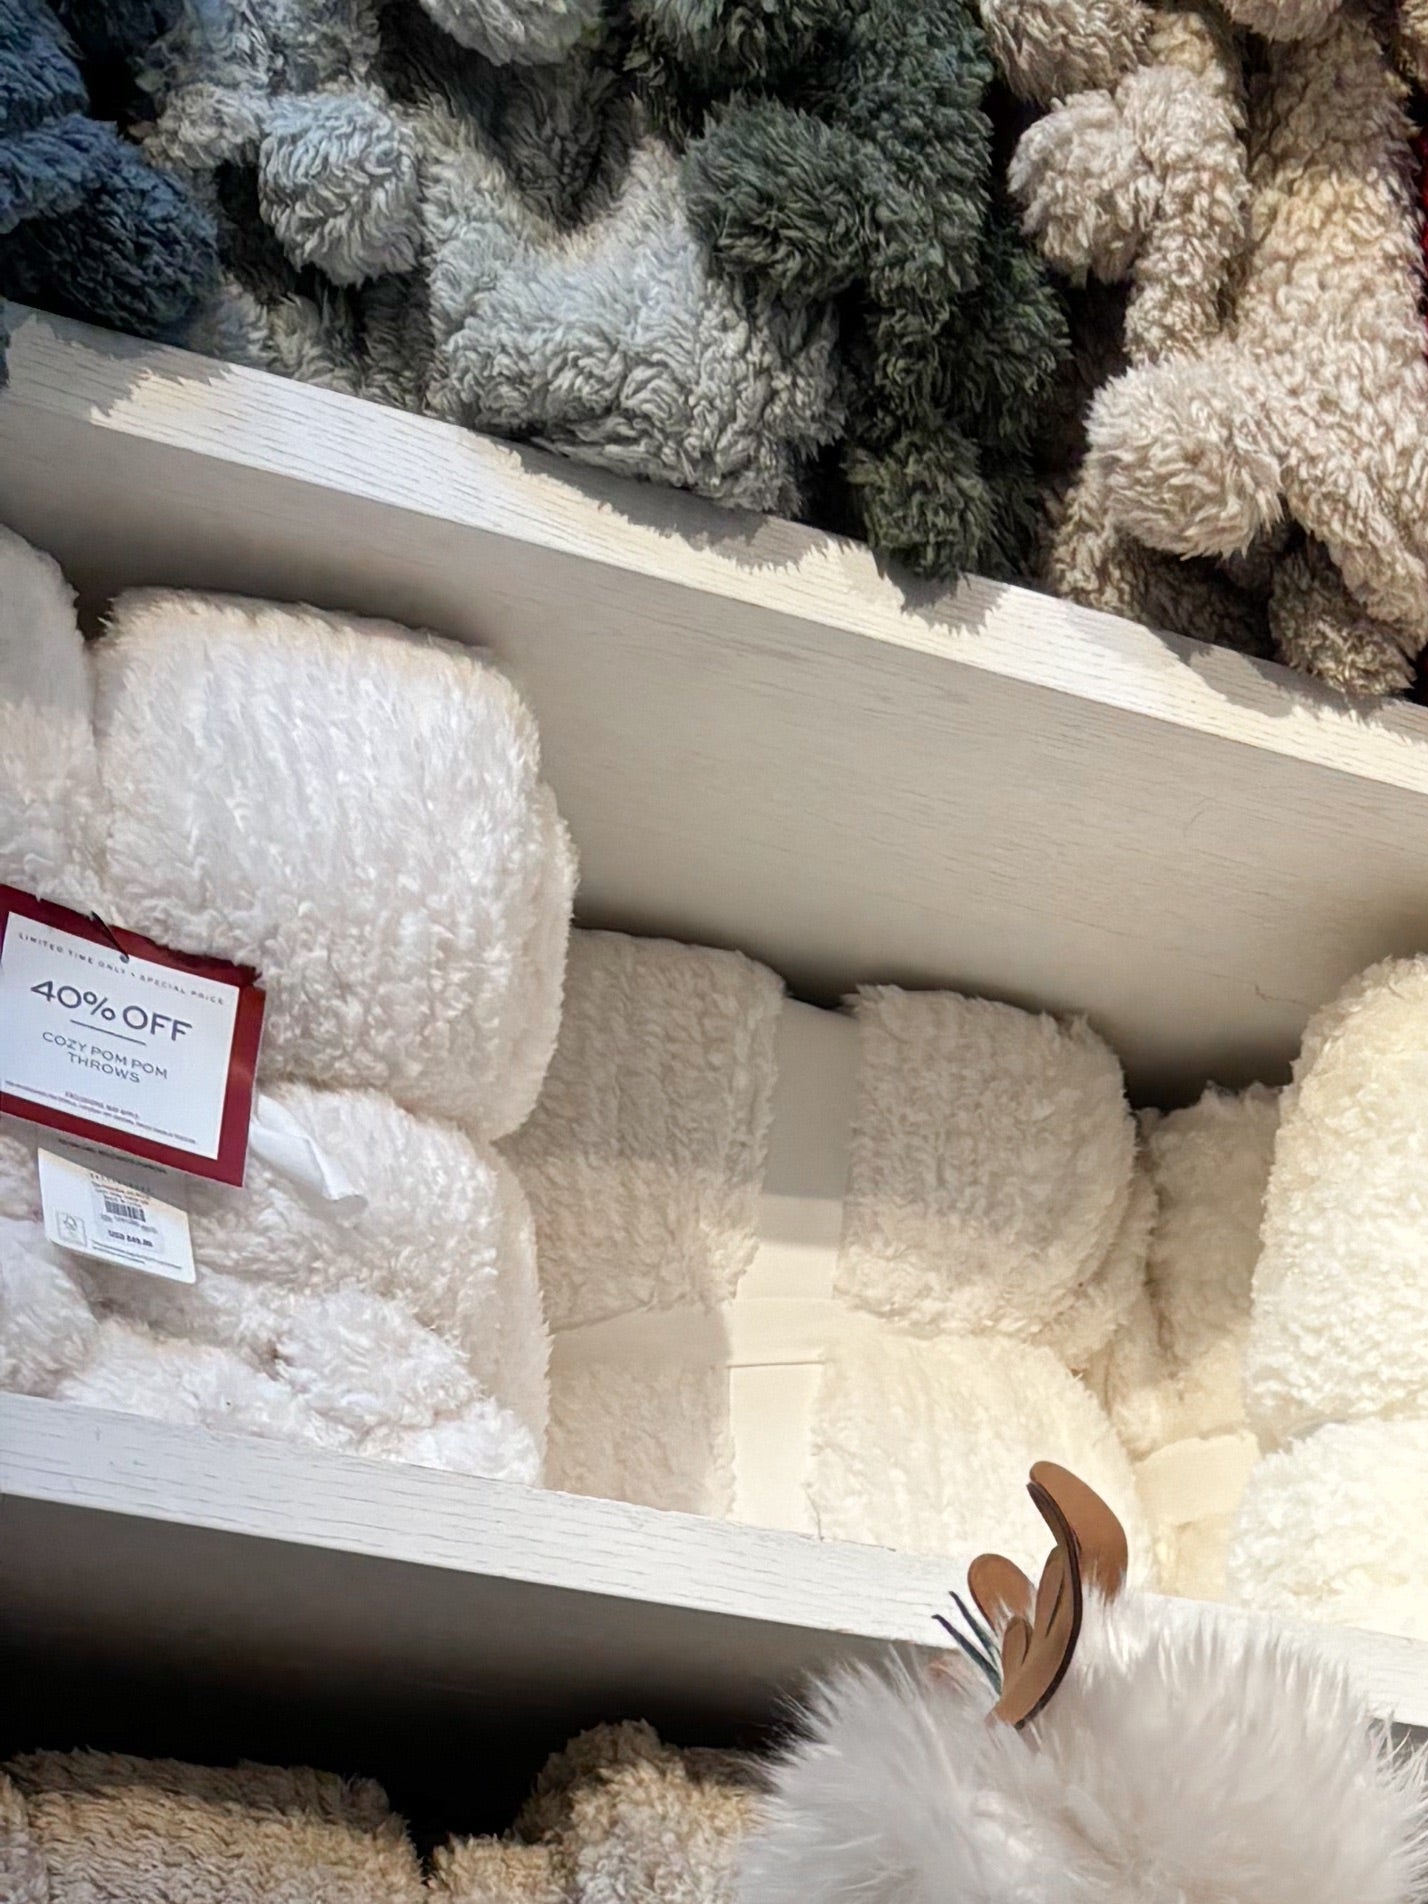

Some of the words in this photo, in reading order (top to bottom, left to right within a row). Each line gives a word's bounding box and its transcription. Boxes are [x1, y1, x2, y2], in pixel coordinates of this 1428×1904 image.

[18, 931, 64, 954] LIMITED
[68, 949, 94, 965] TIME
[98, 960, 127, 976] ONLY
[138, 975, 187, 996] SPECIAL
[190, 989, 225, 1006] PRICE
[30, 980, 116, 1021] 40%
[122, 1005, 193, 1041] OFF
[42, 1031, 87, 1052] COZY
[91, 1045, 128, 1067] POM
[131, 1058, 169, 1080] POM
[66, 1051, 142, 1084] THROWS
